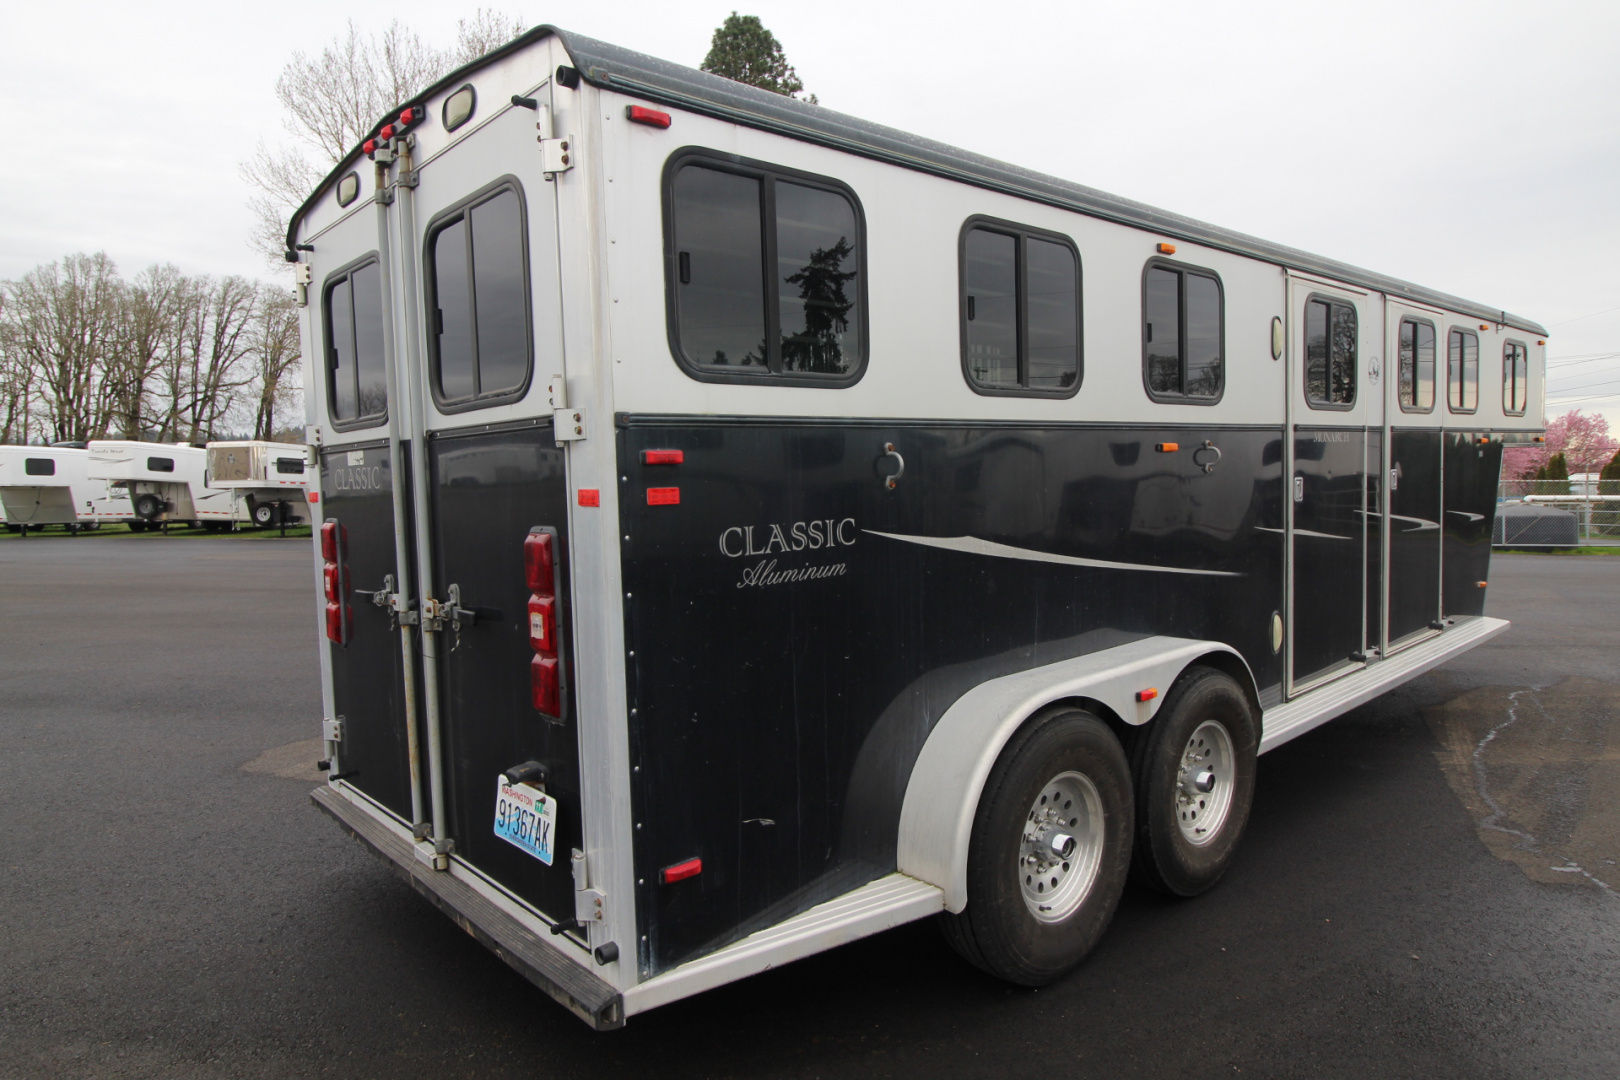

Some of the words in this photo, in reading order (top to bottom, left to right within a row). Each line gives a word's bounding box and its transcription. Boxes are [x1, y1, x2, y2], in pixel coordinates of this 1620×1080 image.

[1313, 431, 1350, 442] MONARCH
[334, 466, 380, 490] CLASSIC
[719, 518, 856, 557] CLASSIC
[736, 559, 847, 588] Aluminum
[502, 785, 533, 806] WASHINGTON
[498, 799, 550, 853] 91367AK
